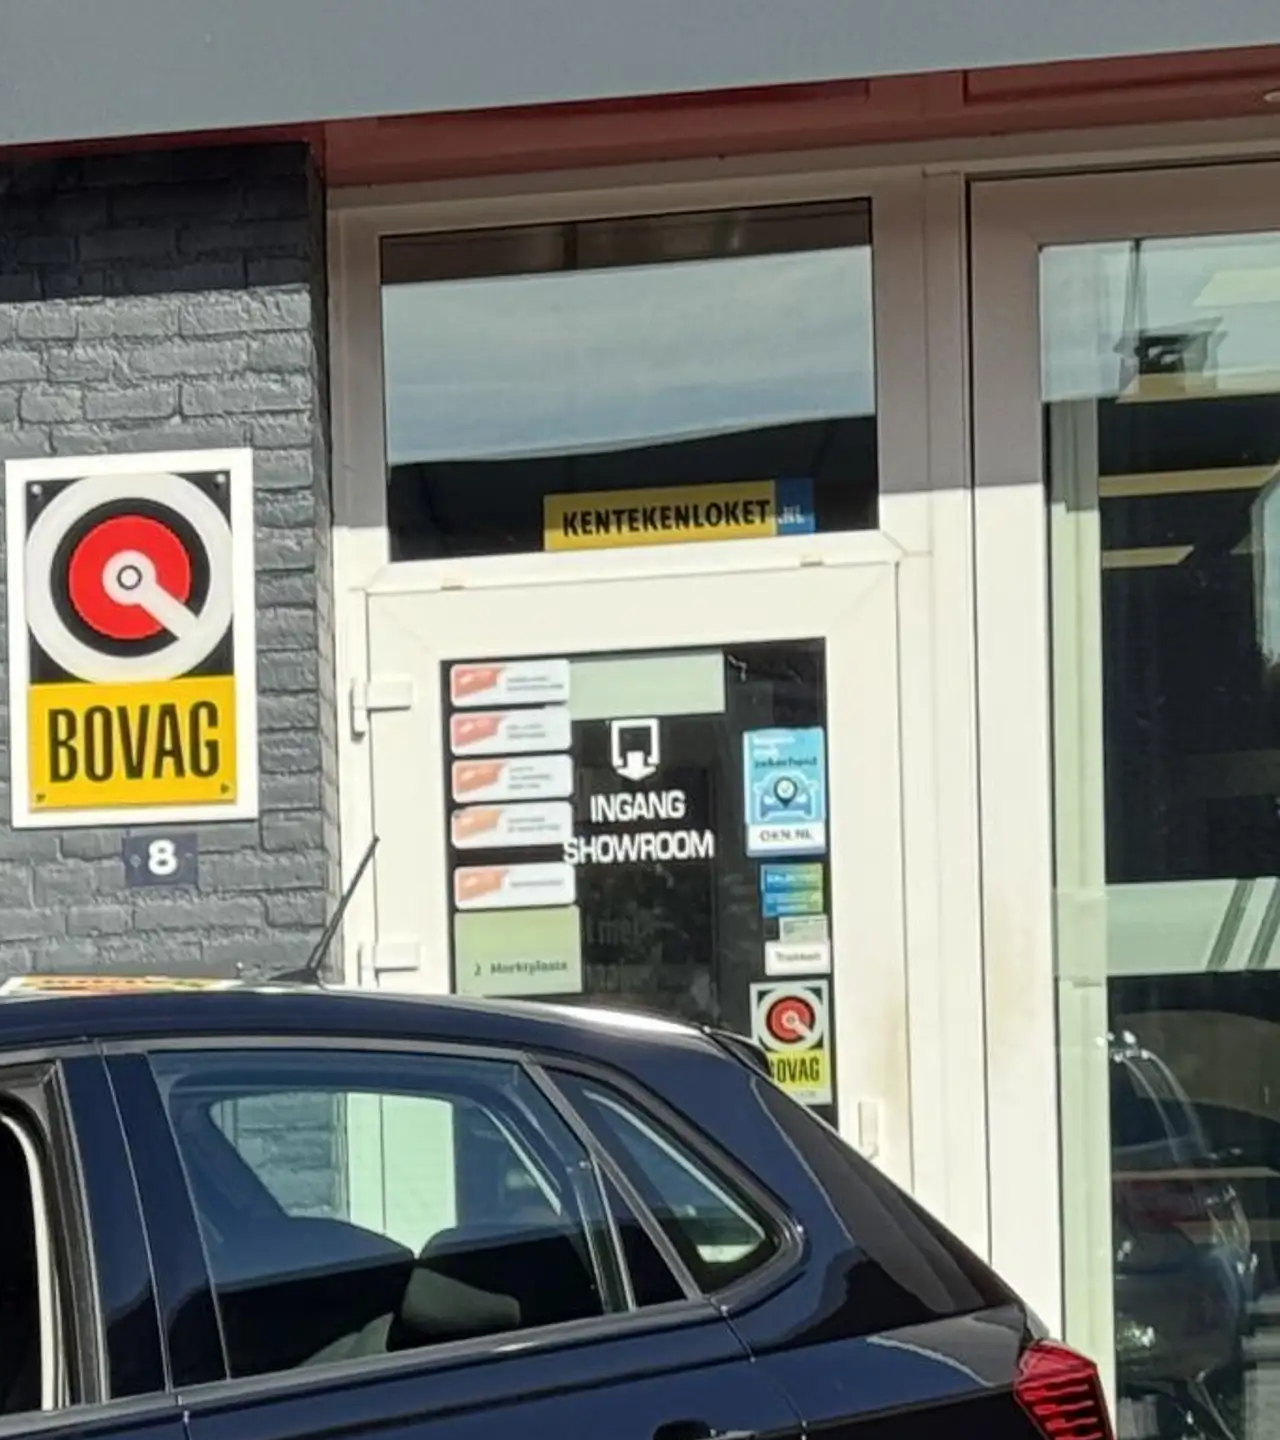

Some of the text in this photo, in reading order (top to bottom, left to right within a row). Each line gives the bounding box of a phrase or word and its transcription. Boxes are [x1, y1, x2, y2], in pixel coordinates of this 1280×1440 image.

[562, 499, 771, 537] KENTEKENLOKET
[48, 701, 220, 783] BOVAG
[591, 789, 687, 823] INGANG
[147, 839, 178, 876] 8
[563, 829, 715, 865] SHOWROOM
